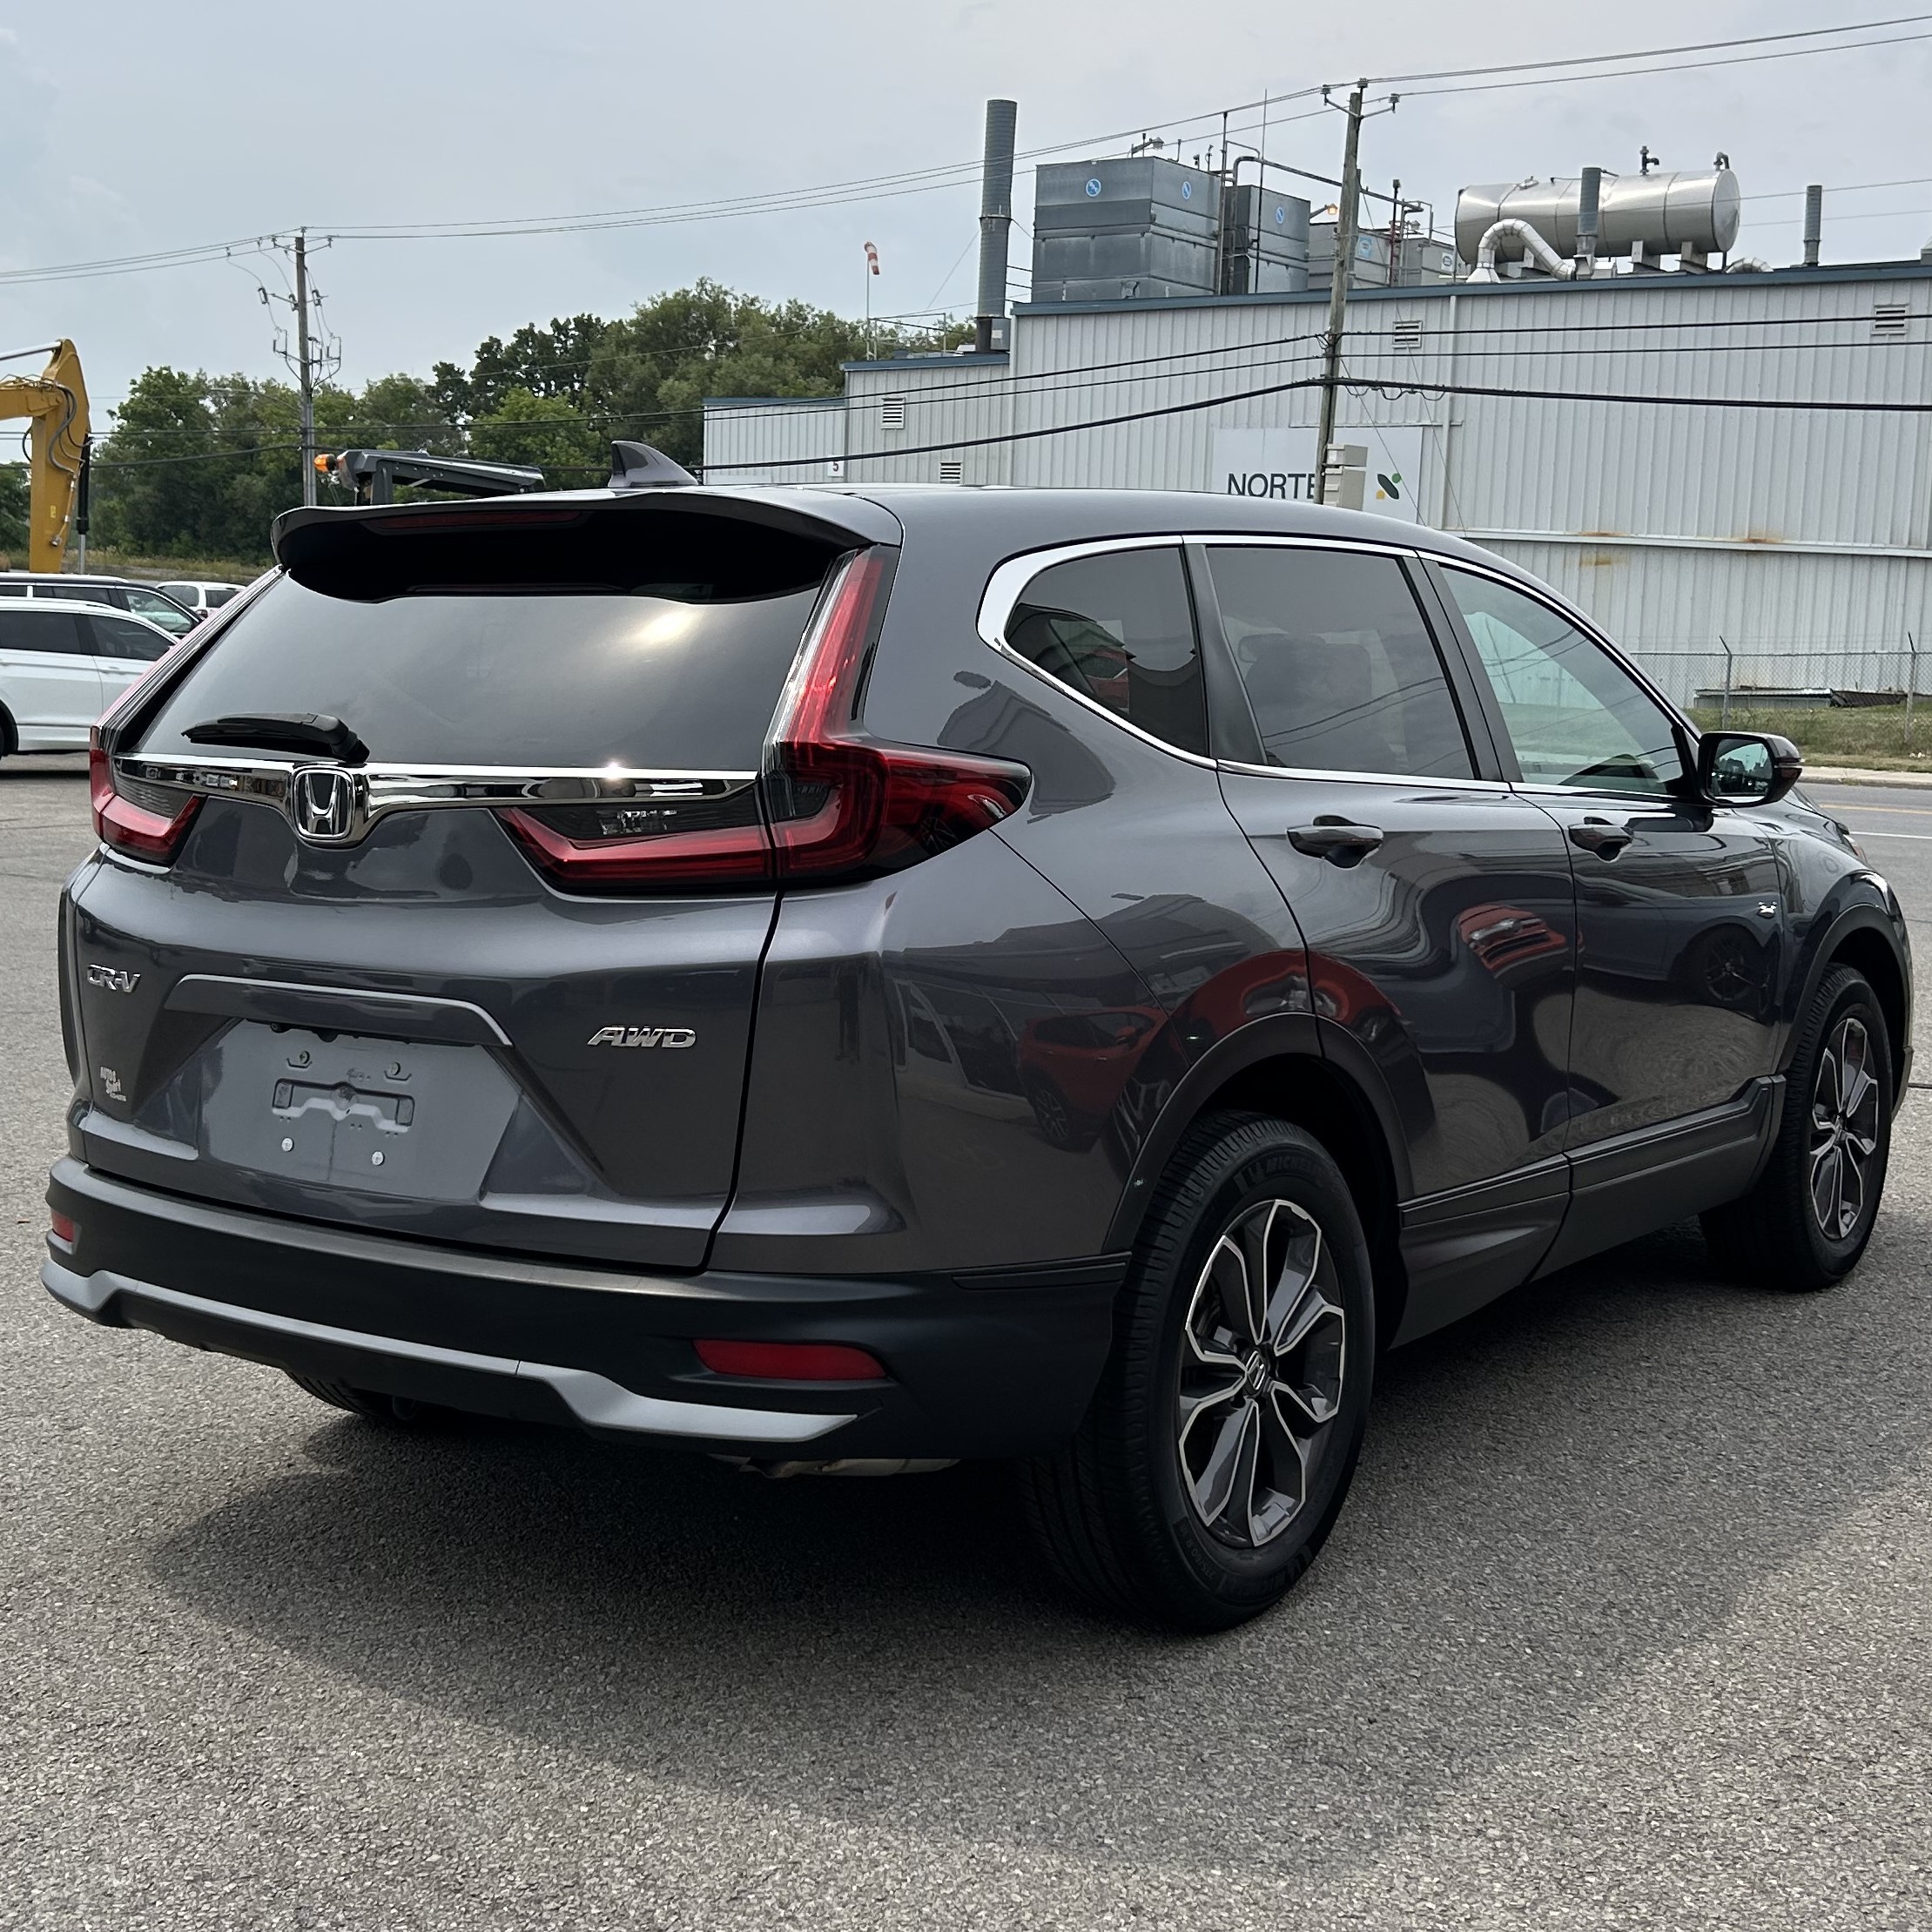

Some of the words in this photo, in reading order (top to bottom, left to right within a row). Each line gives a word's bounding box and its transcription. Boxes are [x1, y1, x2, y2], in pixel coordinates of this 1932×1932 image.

[1227, 473, 1316, 499] NORTE
[88, 964, 141, 993] CR-V
[587, 1026, 697, 1048] AWD
